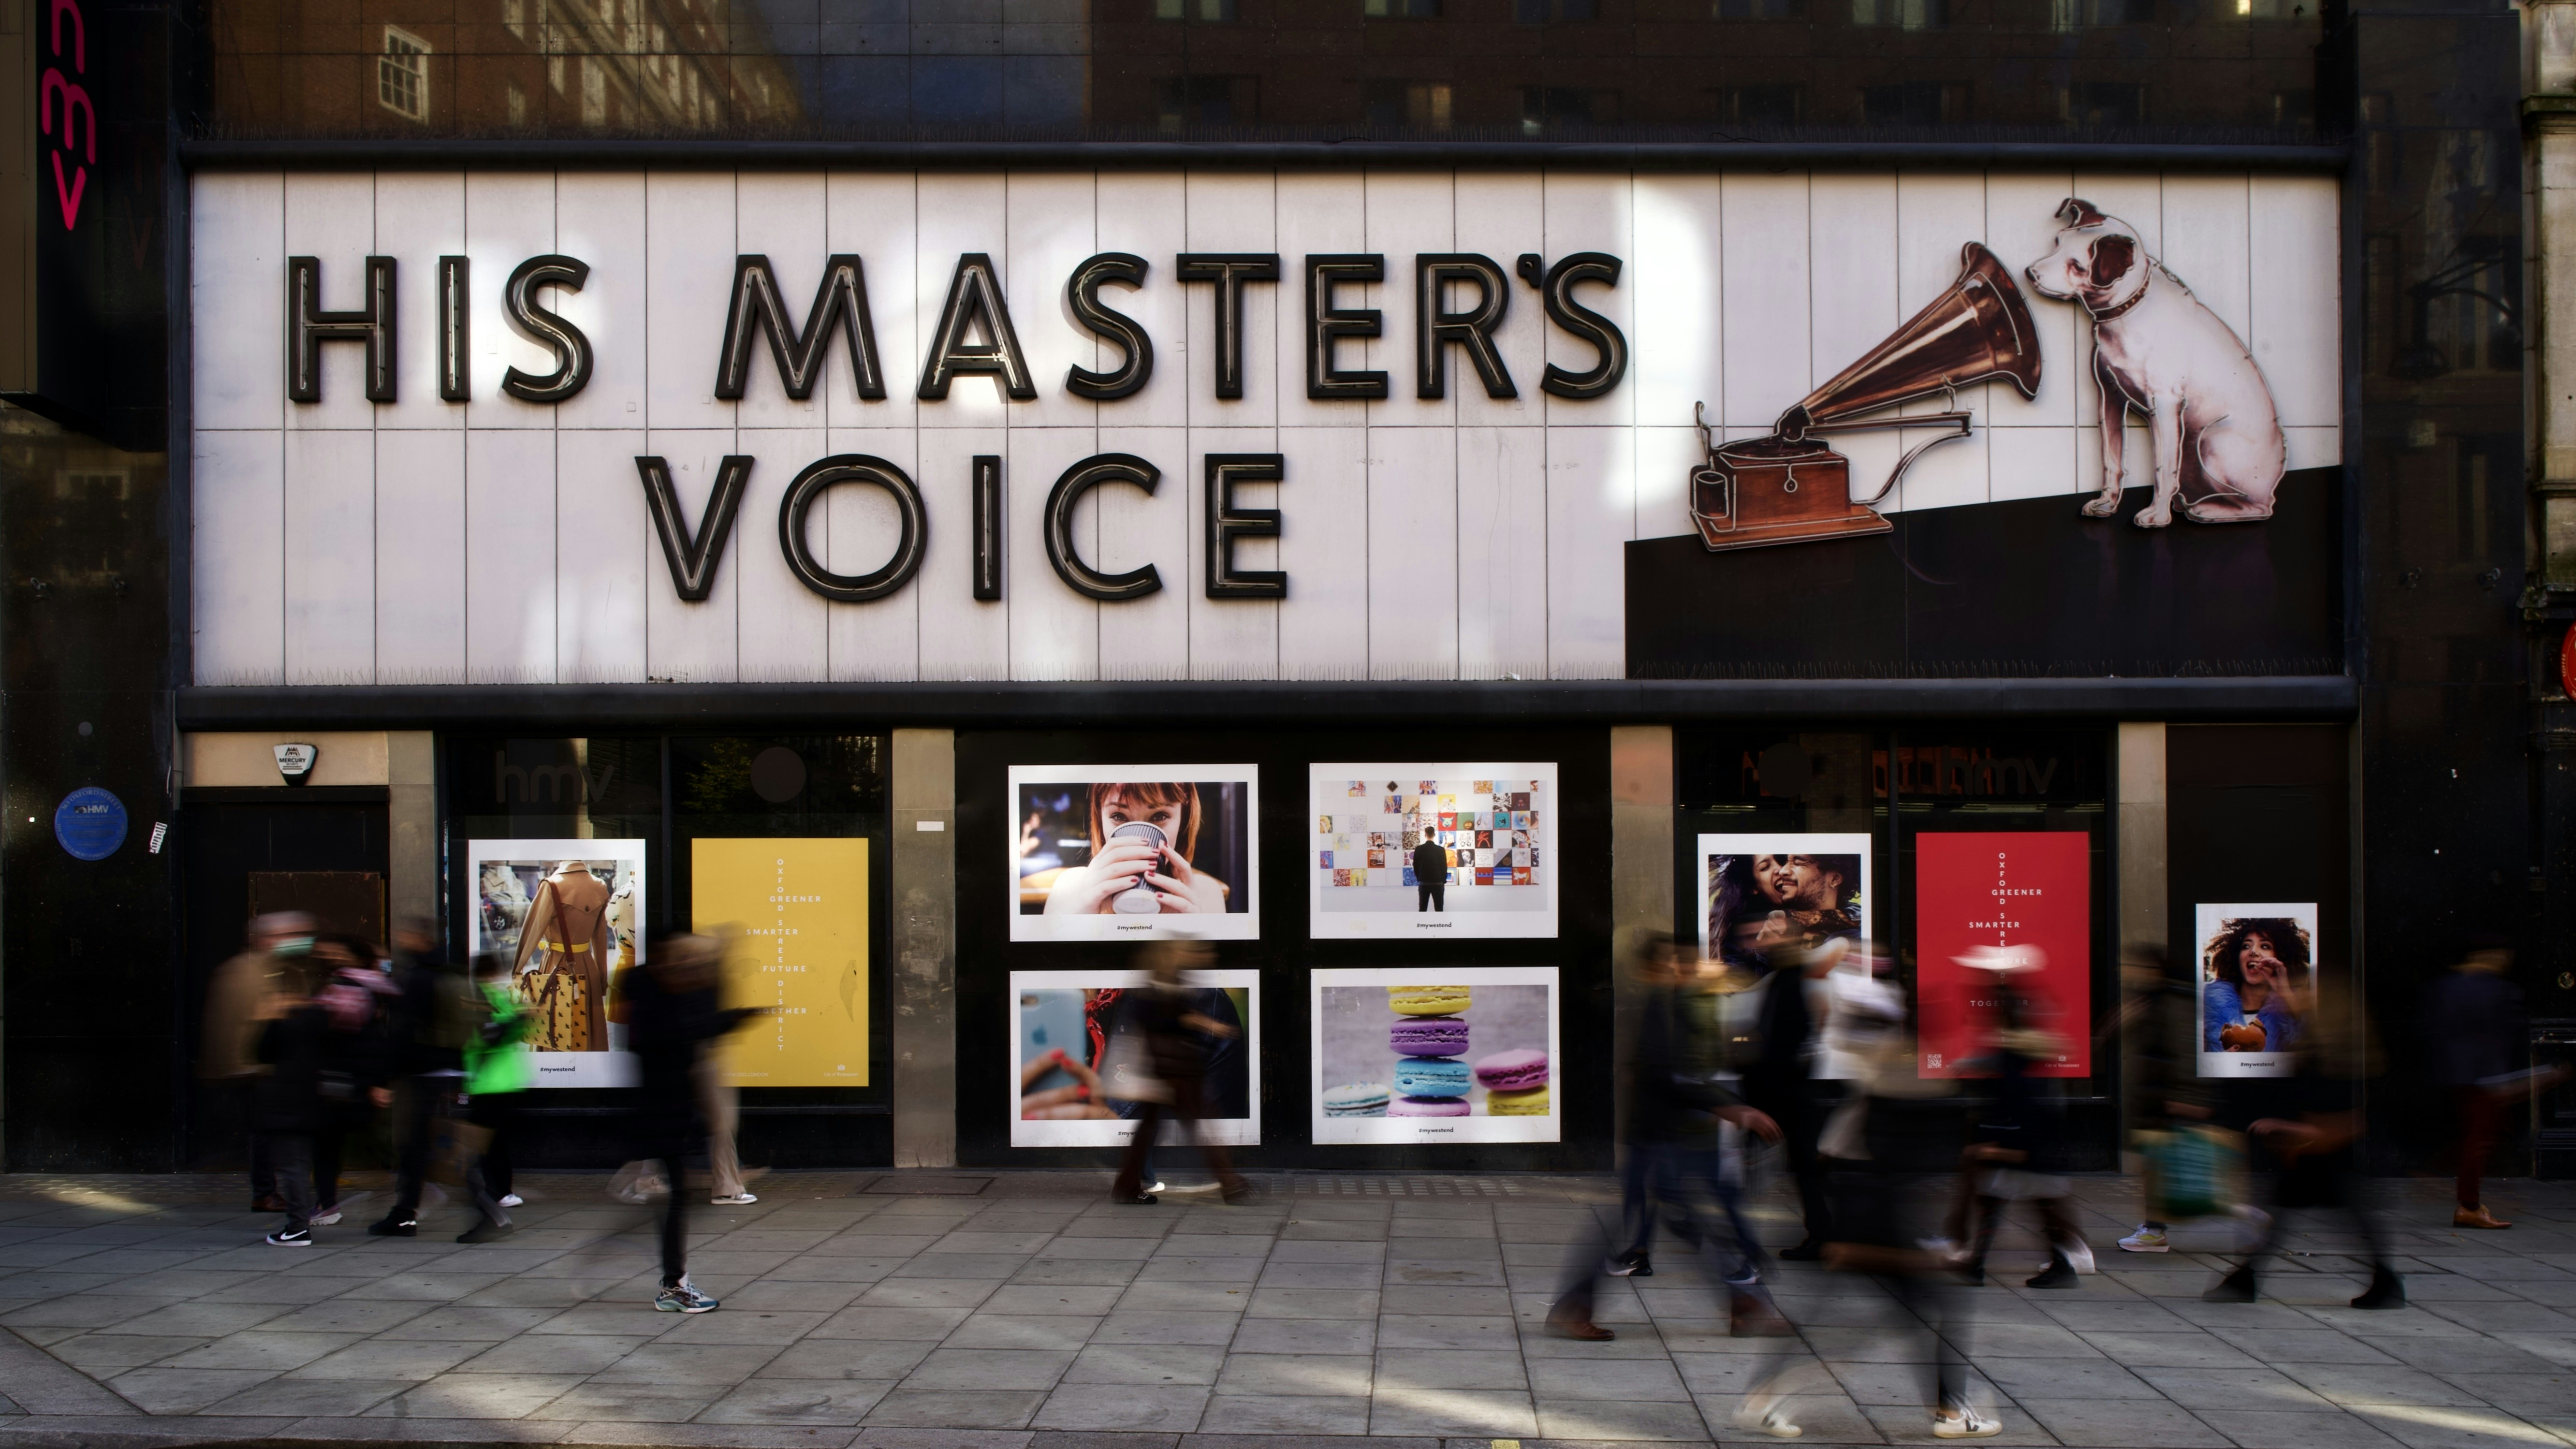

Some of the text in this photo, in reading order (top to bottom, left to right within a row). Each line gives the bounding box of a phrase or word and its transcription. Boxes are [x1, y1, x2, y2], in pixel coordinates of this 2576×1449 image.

[288, 250, 1629, 404] HIS MASTER'S
[635, 453, 1288, 602] VOICE
[1941, 745, 2057, 795] hmv
[496, 750, 615, 803] hmv
[88, 805, 109, 814] HMV
[1117, 924, 1153, 932] #mywestend
[1417, 922, 1452, 930] #mywestend
[540, 1066, 576, 1074] #mywestend
[1419, 1127, 1454, 1135] #mywestend
